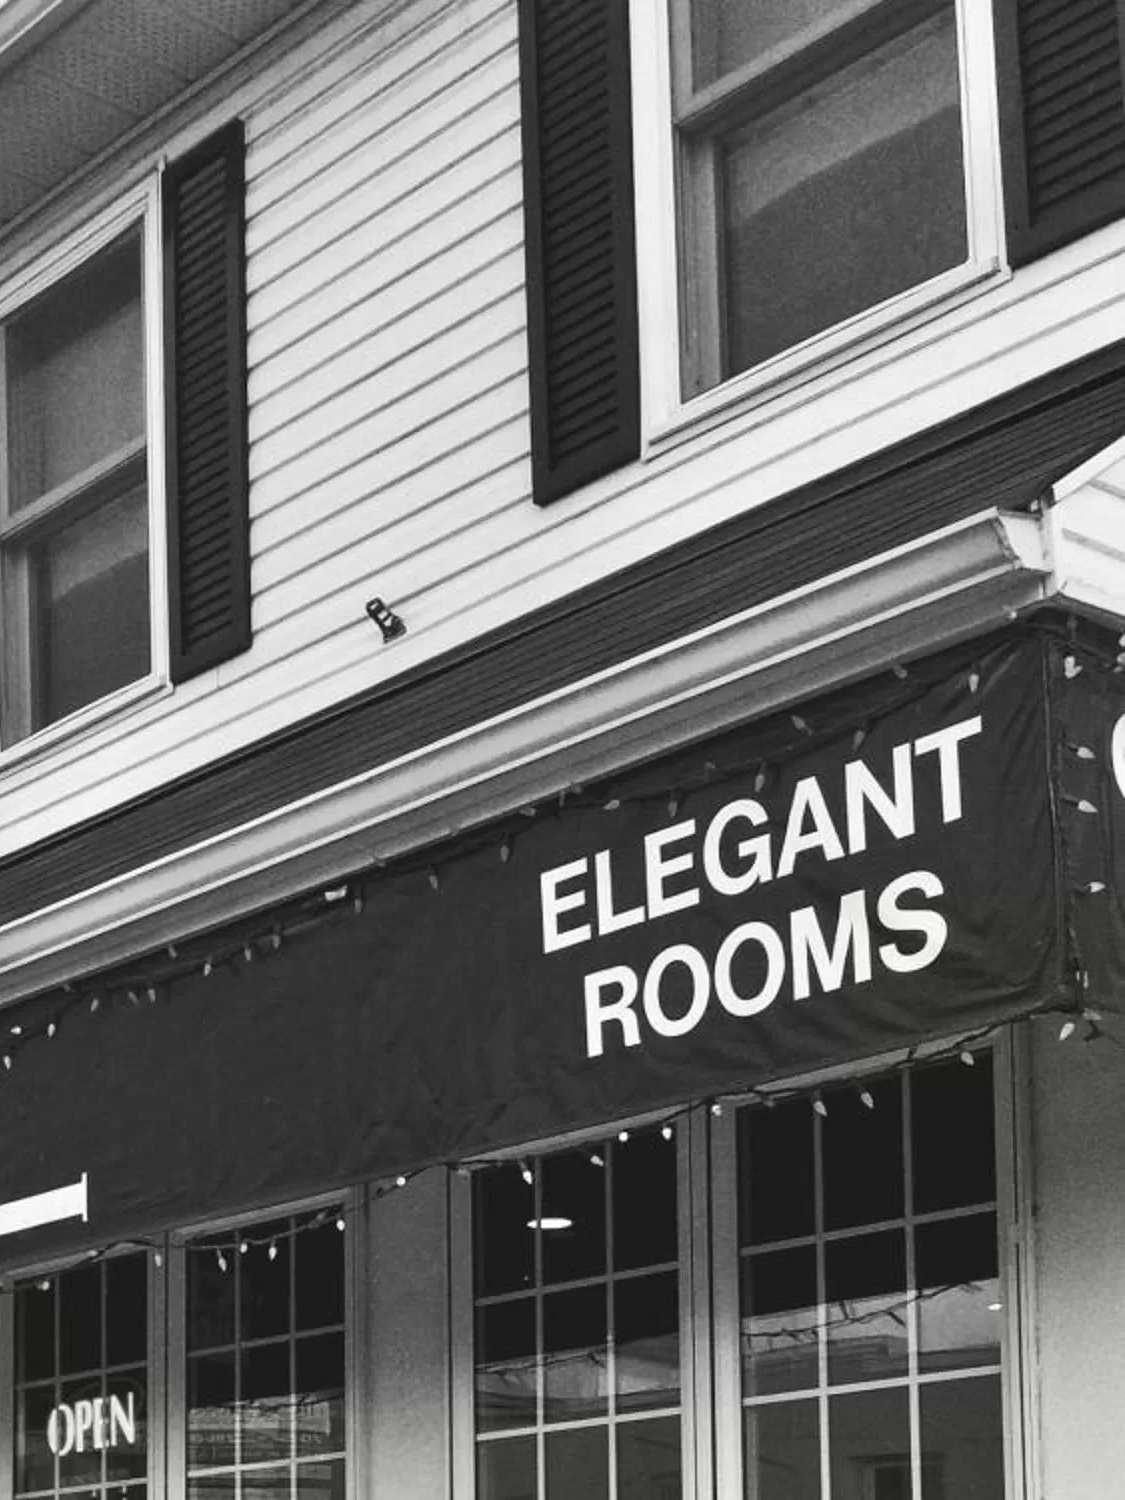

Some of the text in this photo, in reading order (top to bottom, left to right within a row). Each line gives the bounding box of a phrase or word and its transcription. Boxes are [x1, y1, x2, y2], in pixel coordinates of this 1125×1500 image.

[540, 716, 983, 954] ELEGANT
[584, 871, 948, 1058] ROOMS
[47, 1391, 136, 1456] OPEN
